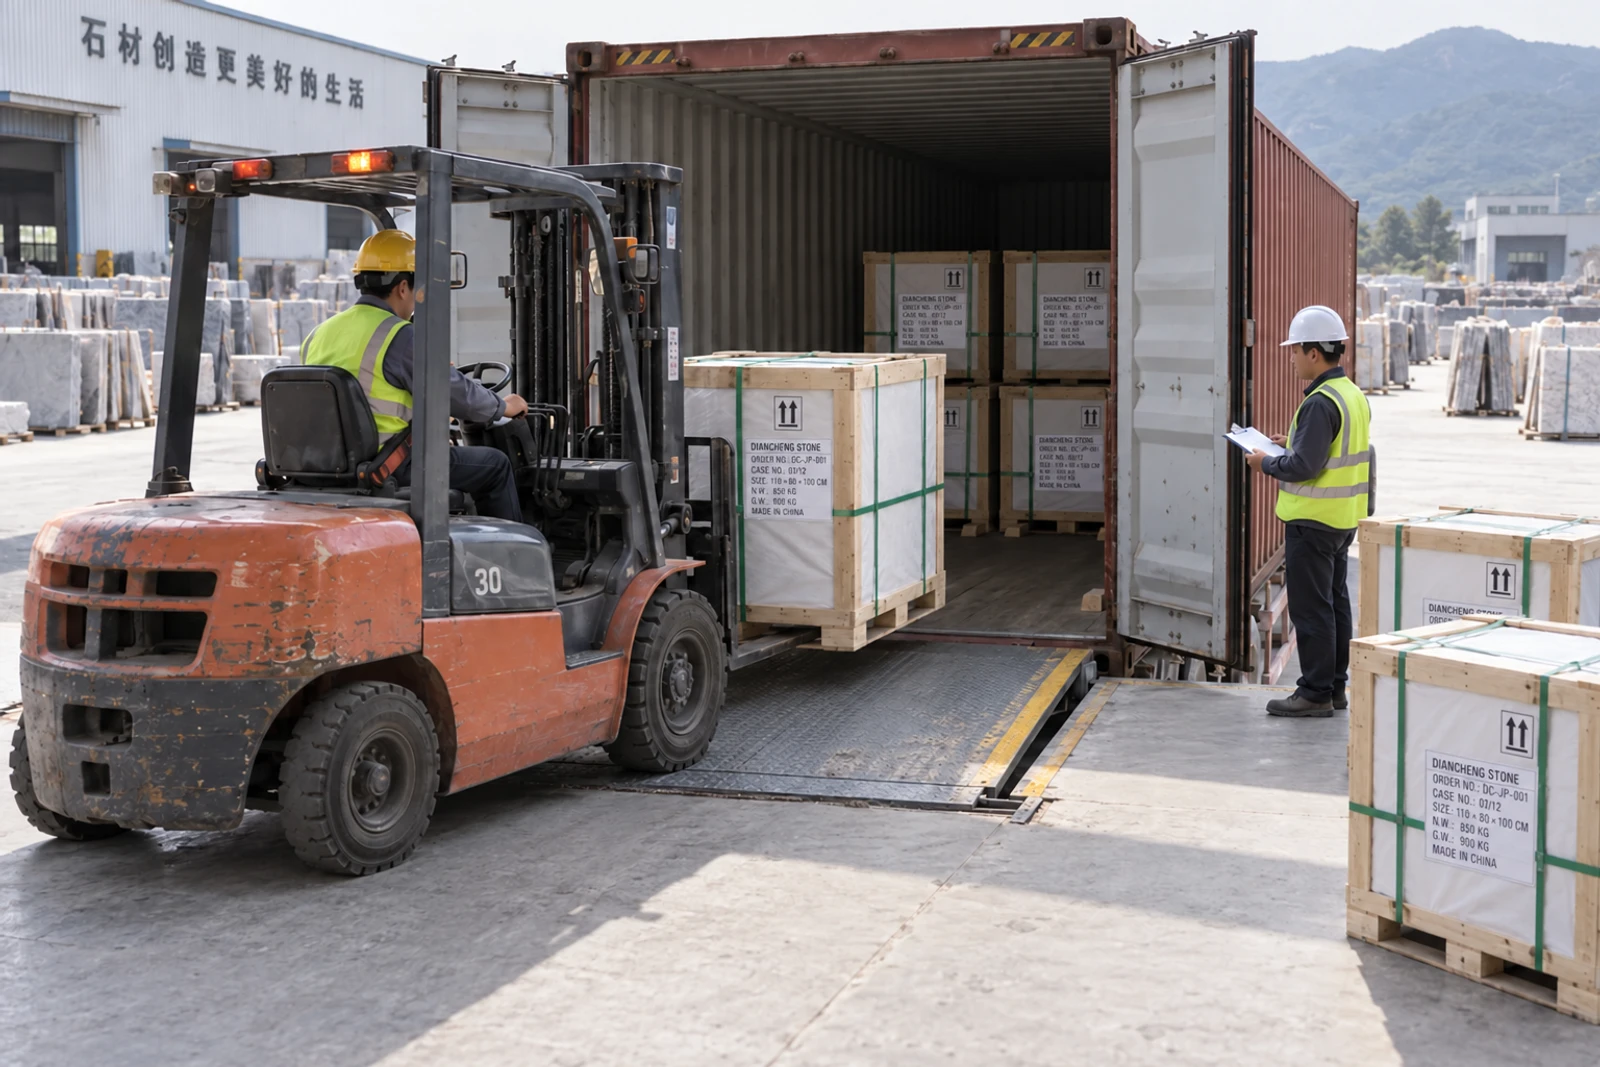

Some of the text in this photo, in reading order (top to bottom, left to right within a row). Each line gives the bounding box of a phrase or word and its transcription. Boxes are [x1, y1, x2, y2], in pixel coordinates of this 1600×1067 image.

[81, 15, 364, 109] 石材创造更美好的生活
[751, 442, 821, 452] DIANCHENG STONE
[751, 466, 770, 474] CASE
[816, 478, 828, 486] CM
[751, 507, 804, 516] MADE IN CHINA
[475, 566, 502, 596] 30
[1428, 603, 1475, 616] DIANCHENG
[1432, 757, 1519, 785] DIANCHENG STONE
[1432, 773, 1528, 802] ORDER NO.: DC-JP-001
[1432, 788, 1454, 802] CASE
[1457, 793, 1476, 806] NO.:
[1432, 801, 1454, 815] SIZE:
[1456, 807, 1470, 819] 110
[1479, 813, 1490, 824] 80
[1498, 816, 1513, 829] 100
[1514, 820, 1529, 833] CM
[1460, 822, 1476, 835] 850
[1477, 827, 1490, 838] KG
[1460, 836, 1476, 849] 900
[1477, 841, 1490, 853] KG
[1432, 844, 1498, 869] MADE IN CHINA
